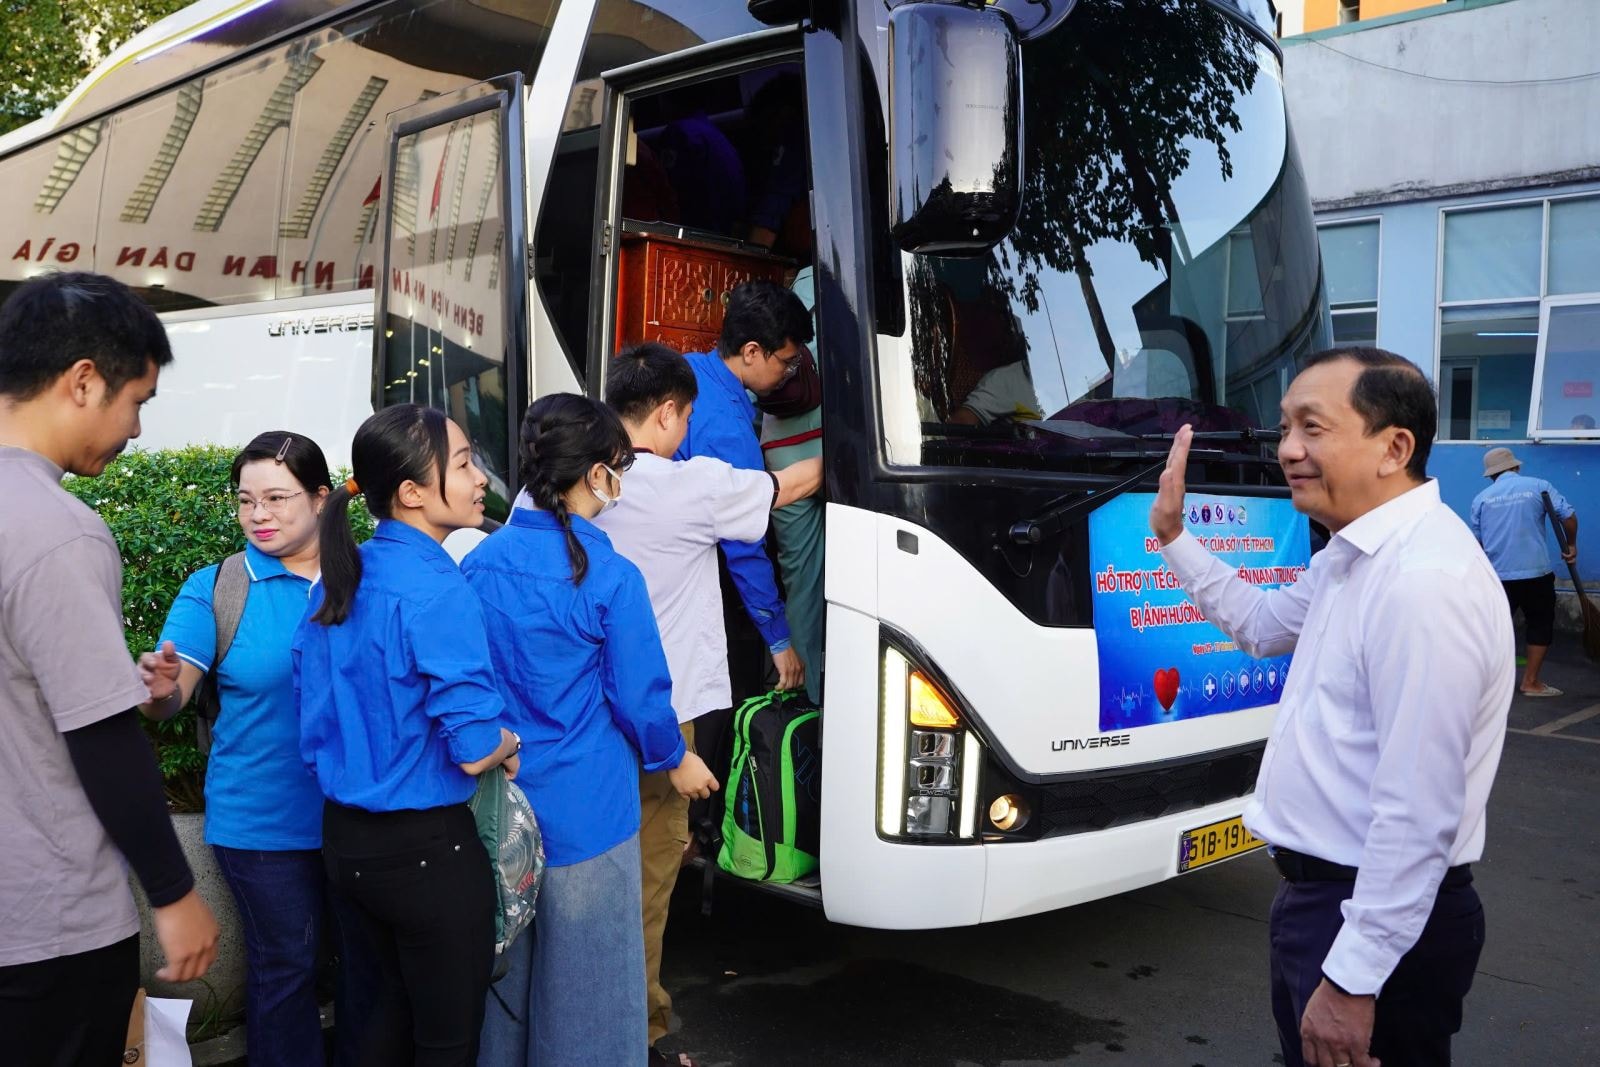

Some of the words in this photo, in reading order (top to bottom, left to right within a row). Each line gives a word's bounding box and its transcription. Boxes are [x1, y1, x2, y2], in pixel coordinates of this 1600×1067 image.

[1097, 566, 1117, 592] HỖ
[1117, 572, 1142, 595] TRỢ
[1151, 567, 1165, 589] TẾ
[1165, 571, 1181, 589] CH
[1131, 609, 1144, 632] BỊ
[1143, 603, 1168, 626] ẢNH
[1051, 734, 1131, 752] UNIVERSE
[1190, 824, 1259, 861] 51B-191.
